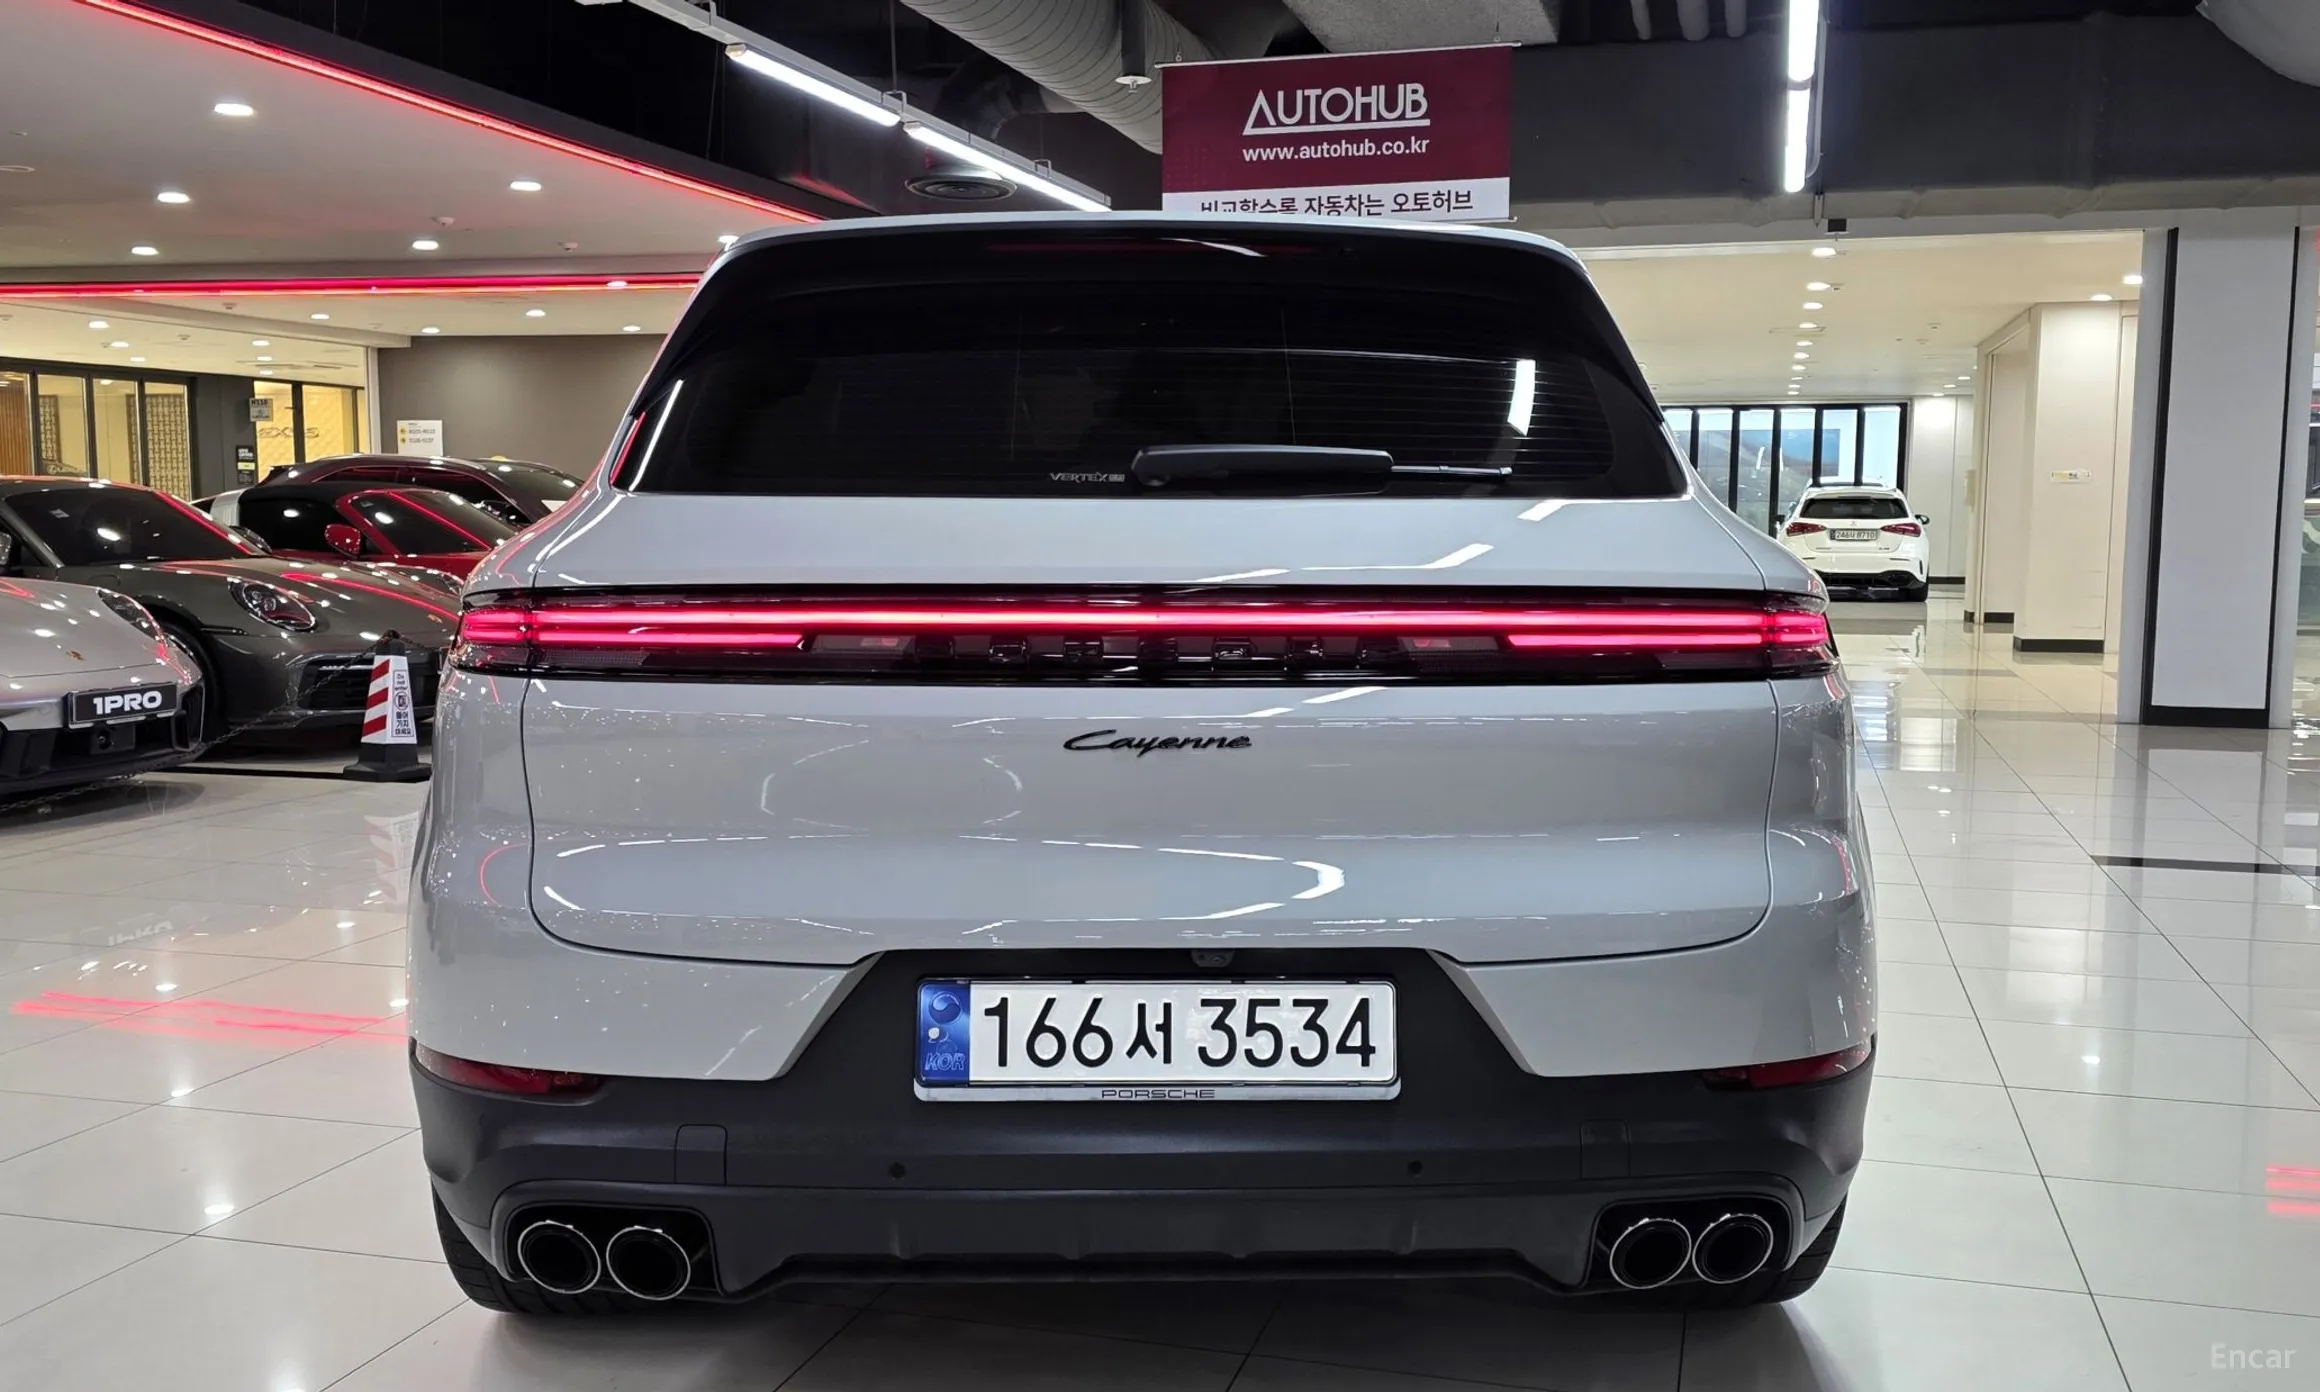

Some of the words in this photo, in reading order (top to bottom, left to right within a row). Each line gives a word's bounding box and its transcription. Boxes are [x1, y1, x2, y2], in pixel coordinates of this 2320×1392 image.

[1243, 83, 1430, 135] AUTOHUB
[1243, 136, 1430, 161] www.autohub.co.kr
[1304, 194, 1385, 217] 자동차는
[1391, 189, 1474, 213] 오토허브
[1049, 471, 1108, 483] VERTEX
[93, 691, 162, 715] 1PRO
[1063, 729, 1253, 757] Cayenne
[984, 997, 1172, 1067] 166서
[1198, 997, 1376, 1067] 3534
[925, 1052, 966, 1071] KOR
[1101, 1089, 1216, 1099] PORSCHE
